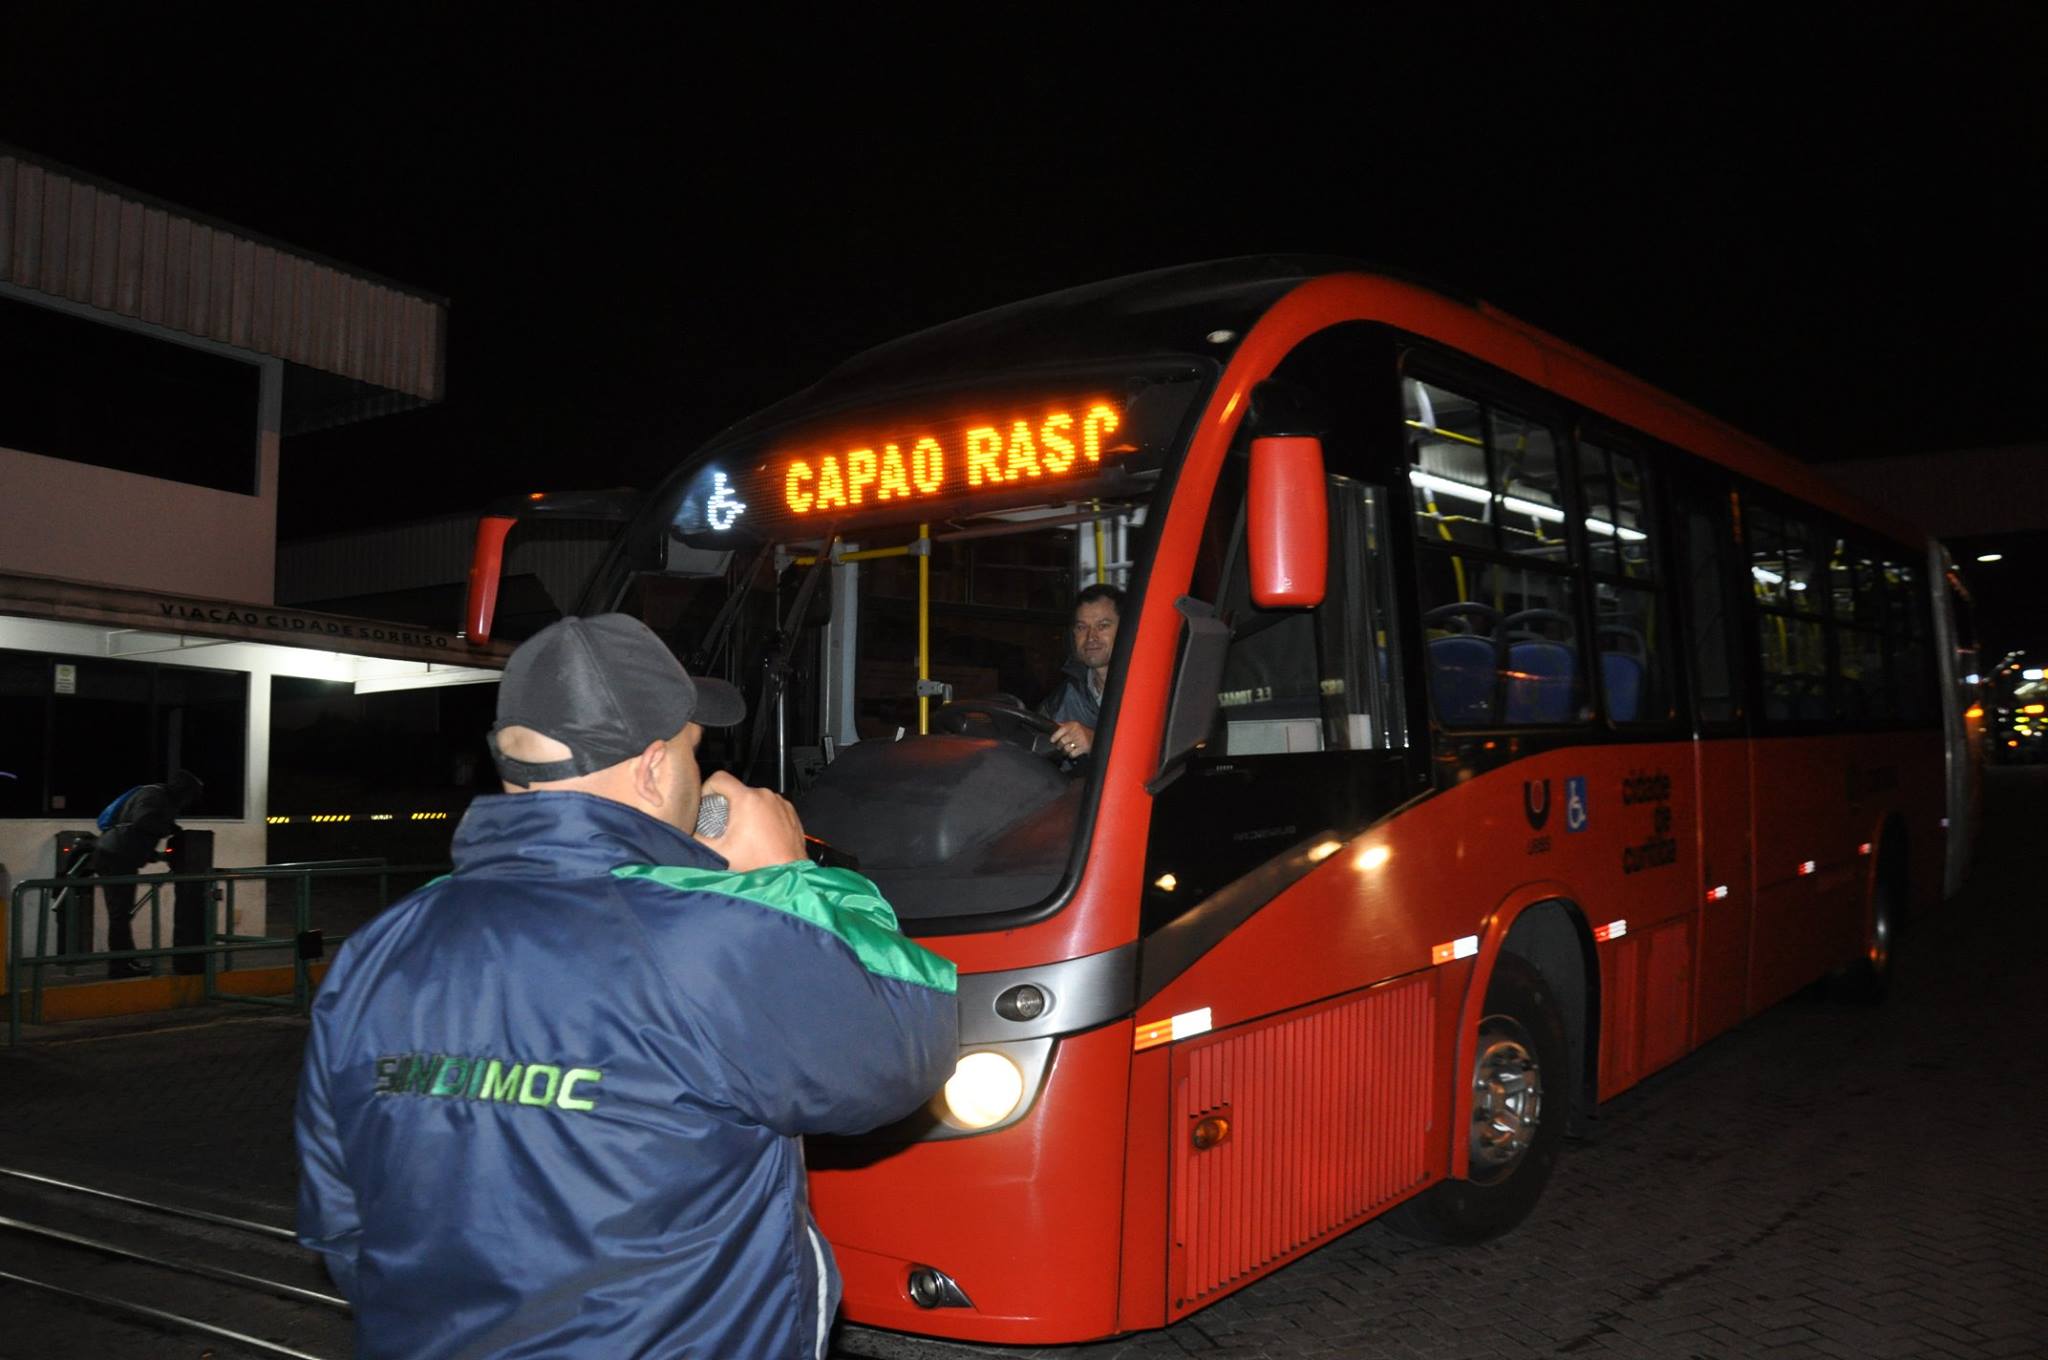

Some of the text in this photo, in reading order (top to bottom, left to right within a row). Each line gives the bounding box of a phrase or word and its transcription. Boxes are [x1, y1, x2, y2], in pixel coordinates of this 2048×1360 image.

[785, 437, 944, 513] CAPAO
[264, 615, 353, 635] CIDADE
[359, 627, 448, 648] SORRISO
[376, 1055, 602, 1112] SINDIMOC
